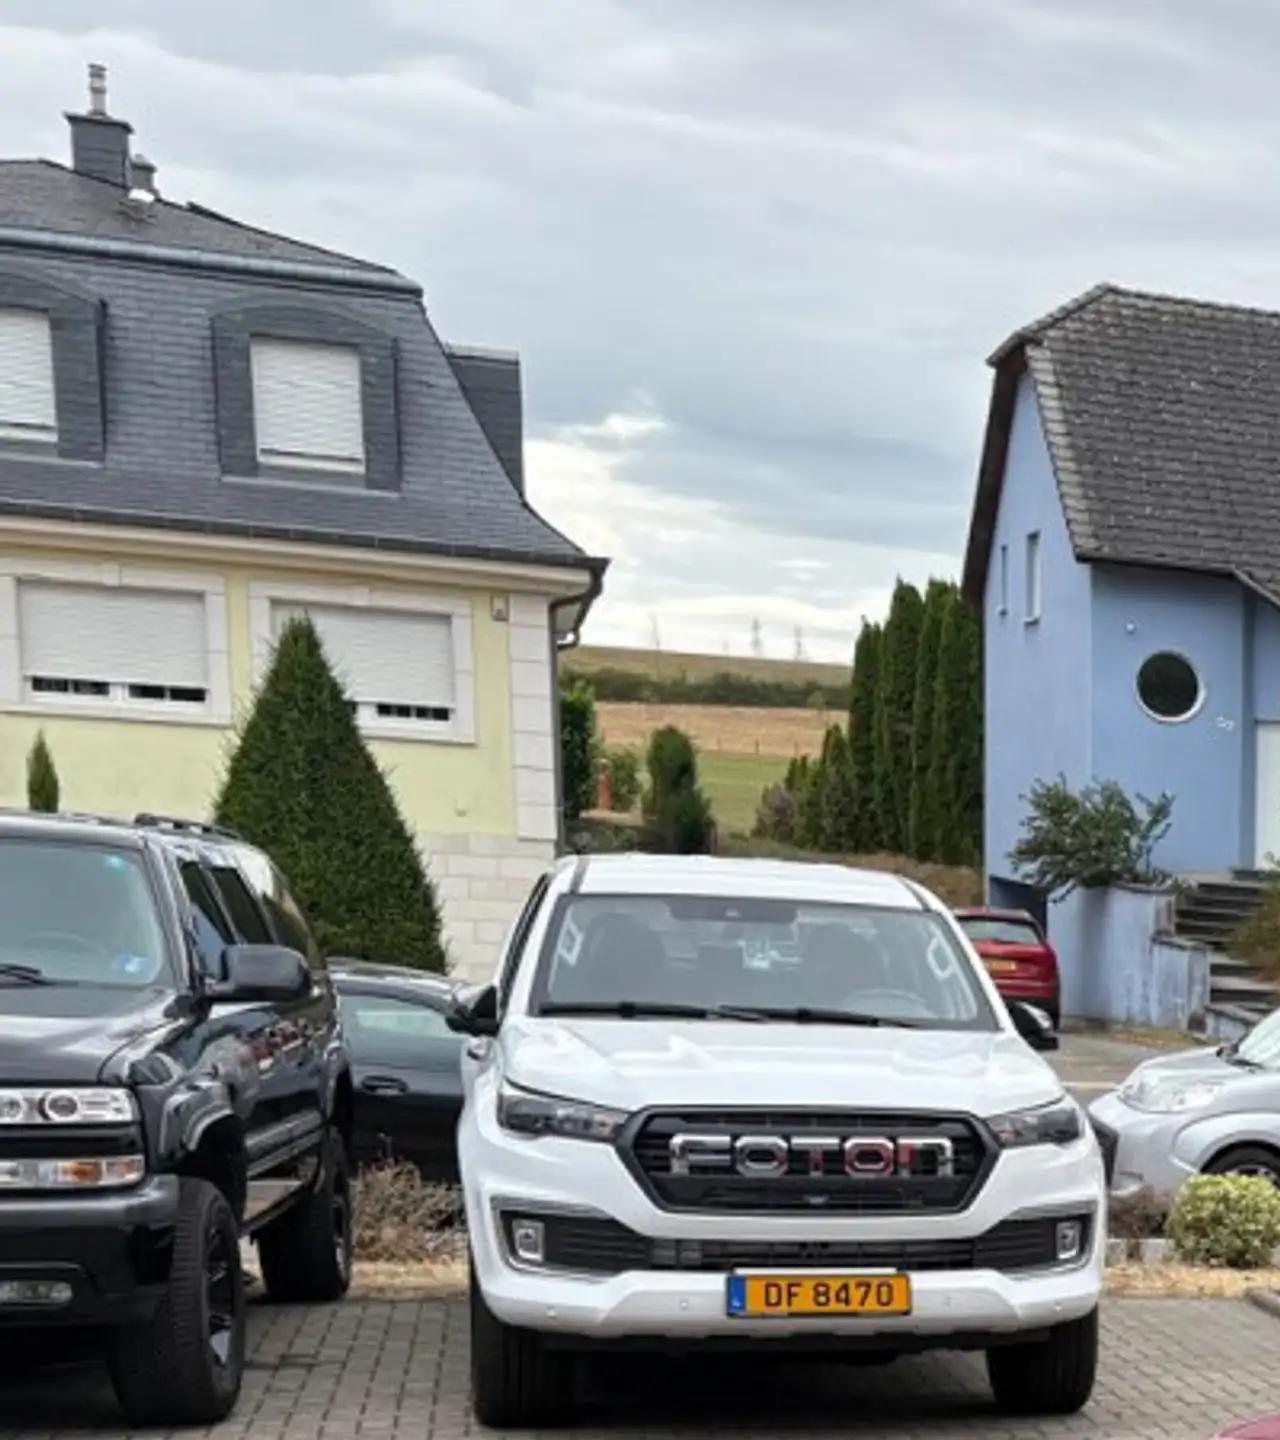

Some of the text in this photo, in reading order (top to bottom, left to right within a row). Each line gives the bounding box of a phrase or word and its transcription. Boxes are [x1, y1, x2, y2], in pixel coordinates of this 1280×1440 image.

[669, 1132, 954, 1178] FOTON
[764, 1282, 894, 1307] DF 8470
